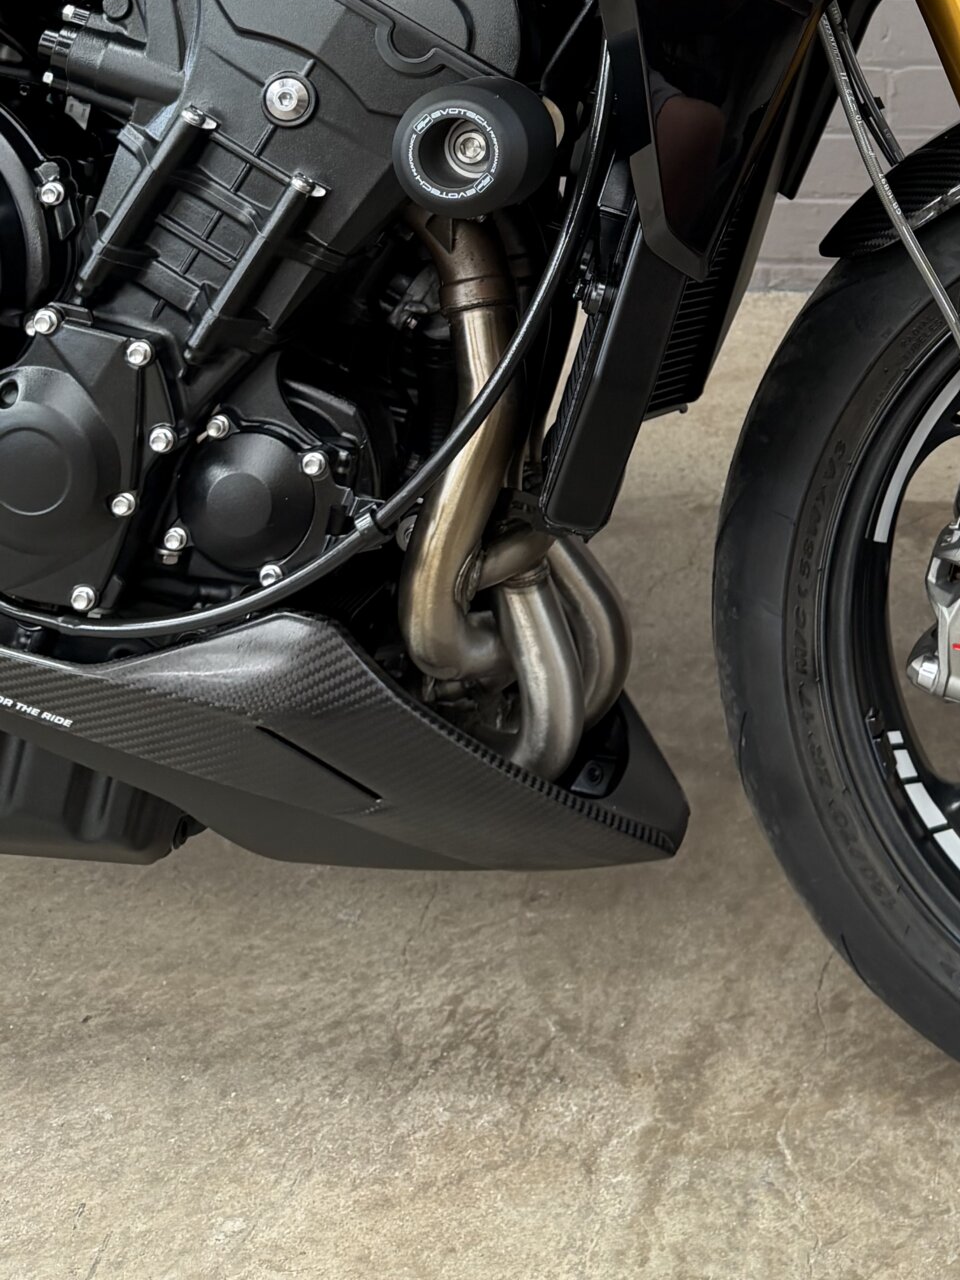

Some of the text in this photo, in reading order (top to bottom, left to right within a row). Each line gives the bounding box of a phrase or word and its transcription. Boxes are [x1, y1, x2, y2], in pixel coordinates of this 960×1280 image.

[430, 108, 500, 173] EVOTECH PERFORMANCE
[415, 174, 476, 199] EVOTECH
[16, 702, 40, 716] THE
[41, 711, 73, 728] RIDE
